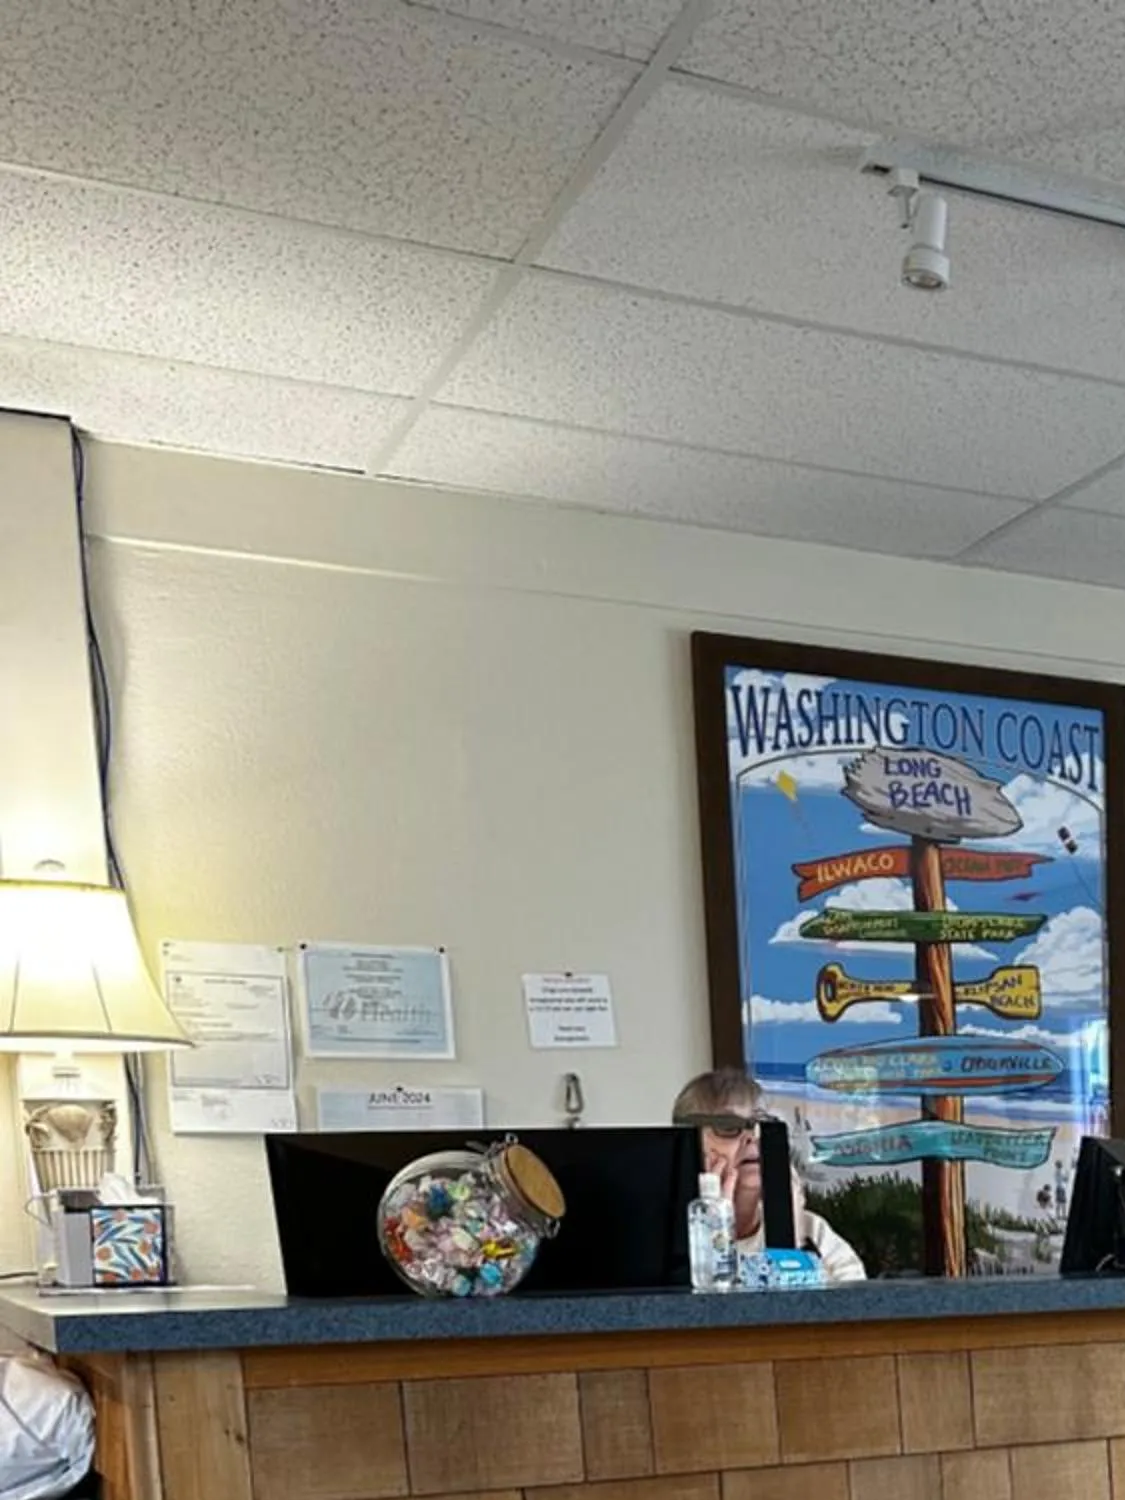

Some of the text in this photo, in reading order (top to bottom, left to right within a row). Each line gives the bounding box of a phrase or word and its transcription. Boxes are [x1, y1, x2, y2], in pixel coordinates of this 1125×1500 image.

[730, 685, 1100, 792] WASHINGTON COAST
[884, 756, 942, 777] LONG
[887, 780, 973, 817] BEACH
[816, 854, 895, 884] ILWACO
